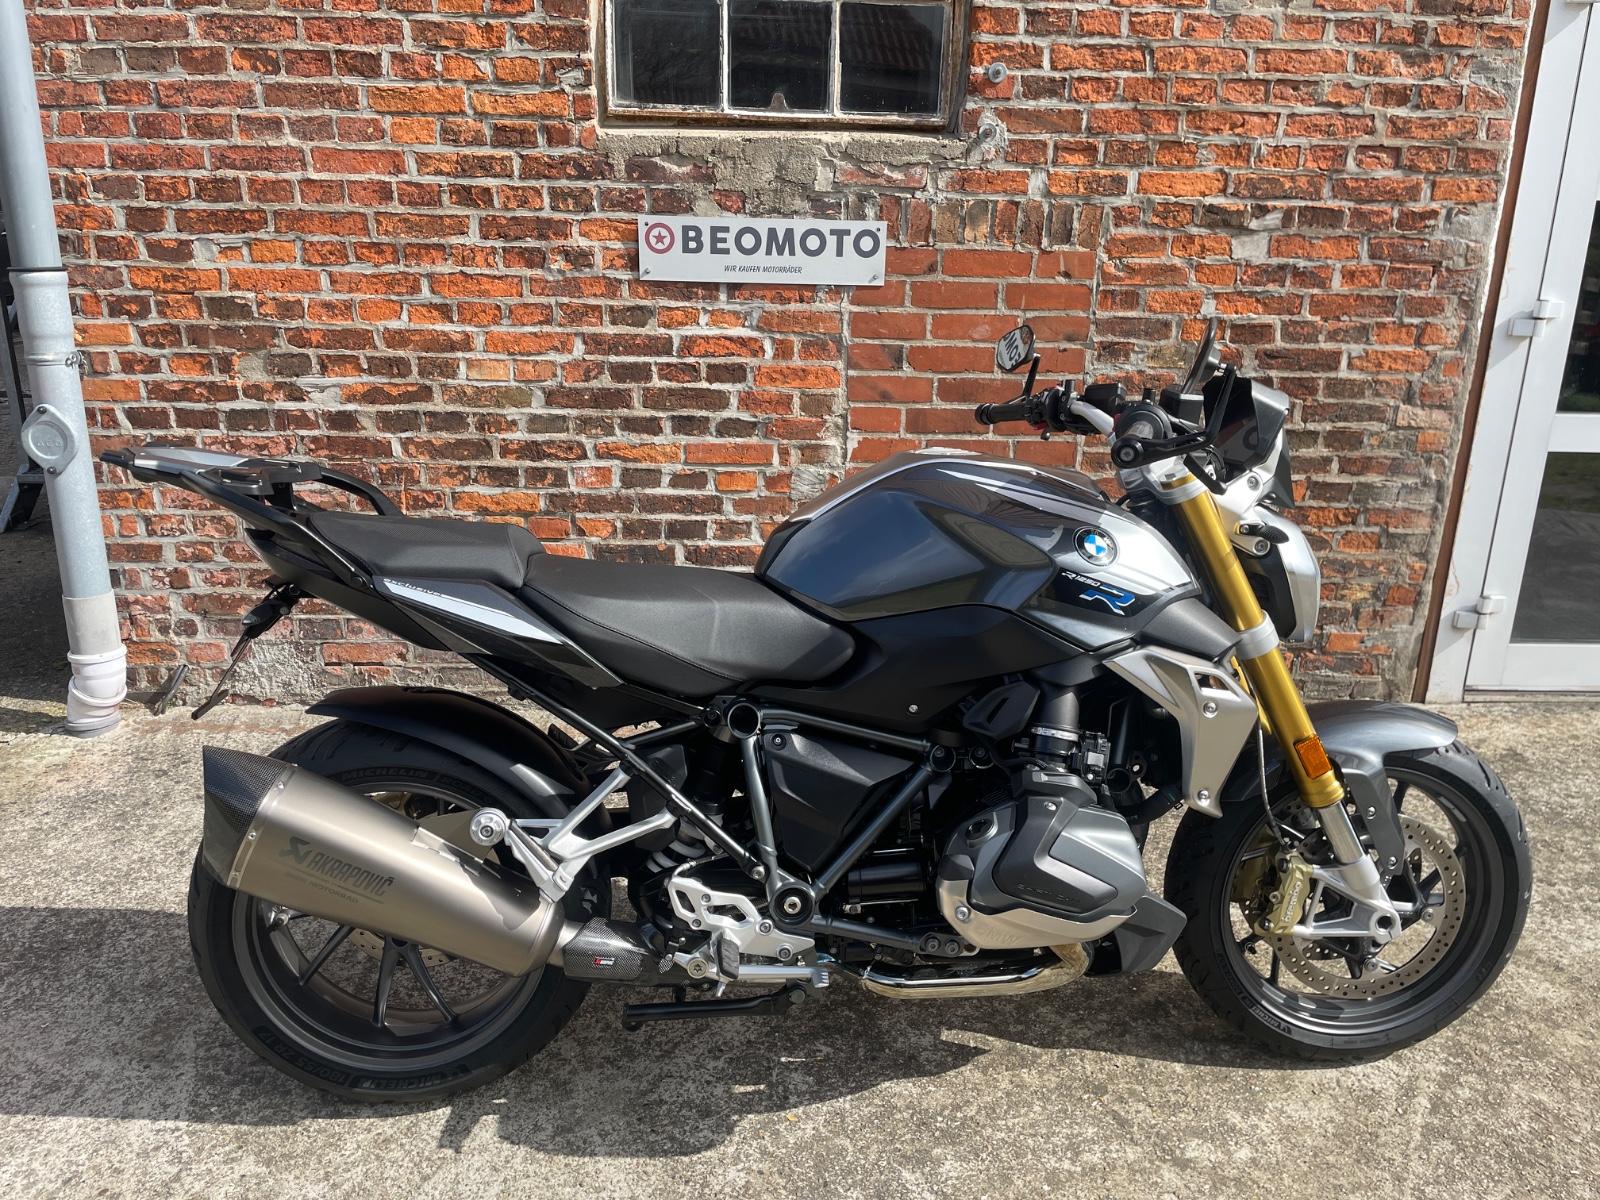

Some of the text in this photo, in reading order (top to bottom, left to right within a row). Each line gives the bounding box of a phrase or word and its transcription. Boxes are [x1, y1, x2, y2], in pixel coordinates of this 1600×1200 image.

[681, 224, 881, 259] BEOMOTO
[723, 264, 803, 274] WIR KAUFEN MOTORRÄDER
[1281, 881, 1303, 923] brembo
